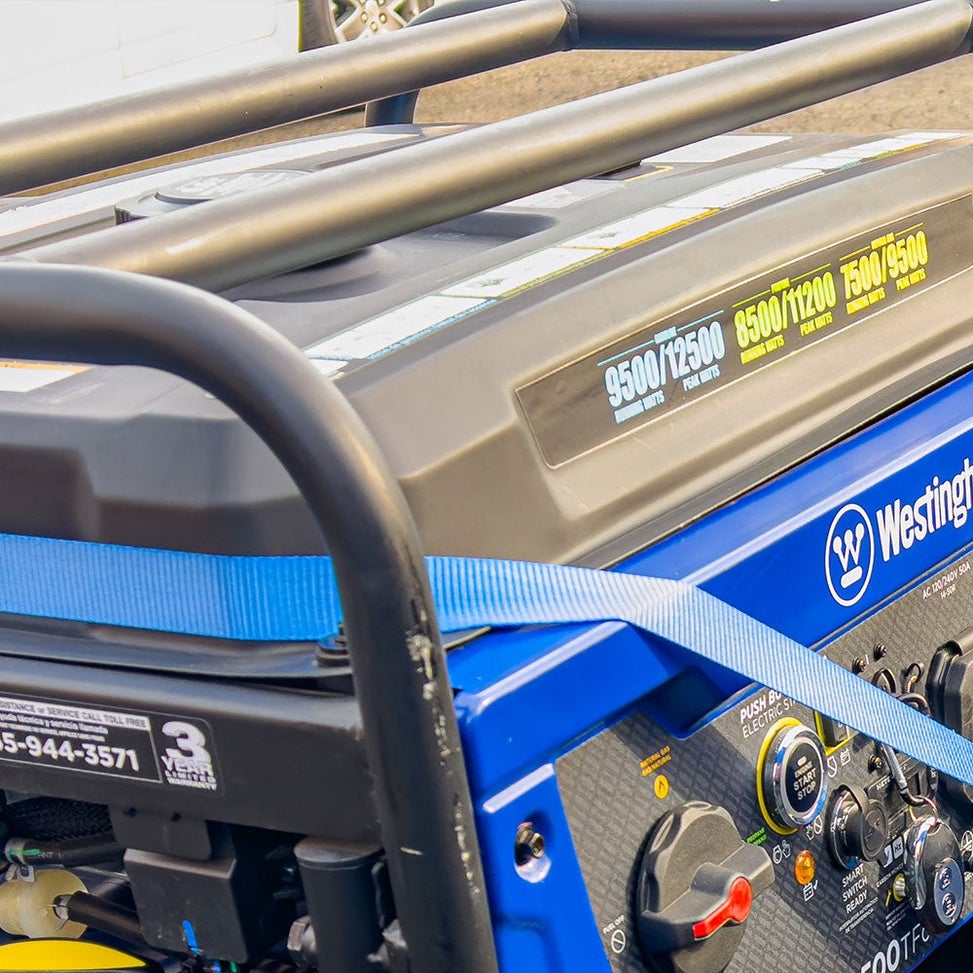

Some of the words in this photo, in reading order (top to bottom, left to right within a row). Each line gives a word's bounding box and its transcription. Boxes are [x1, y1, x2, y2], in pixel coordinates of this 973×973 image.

[840, 230, 928, 300] 7500/9500
[734, 271, 837, 348] 8500/11200
[605, 321, 725, 408] 9500/12500
[682, 376, 701, 392] PEAK
[922, 587, 931, 600] AC
[931, 568, 958, 593] 120/240V
[958, 561, 971, 576] 50A
[81, 711, 102, 722] CALL
[740, 694, 767, 724] PUSH
[742, 703, 783, 738] ELECTRIC
[0, 731, 140, 772] 5-944-3571
[161, 721, 211, 762] 3
[160, 755, 214, 777] YEAR
[793, 768, 816, 790] START
[797, 781, 816, 800] STOP
[842, 863, 864, 888] SMART
[842, 876, 868, 902] SWITCH
[845, 889, 867, 914] READY
